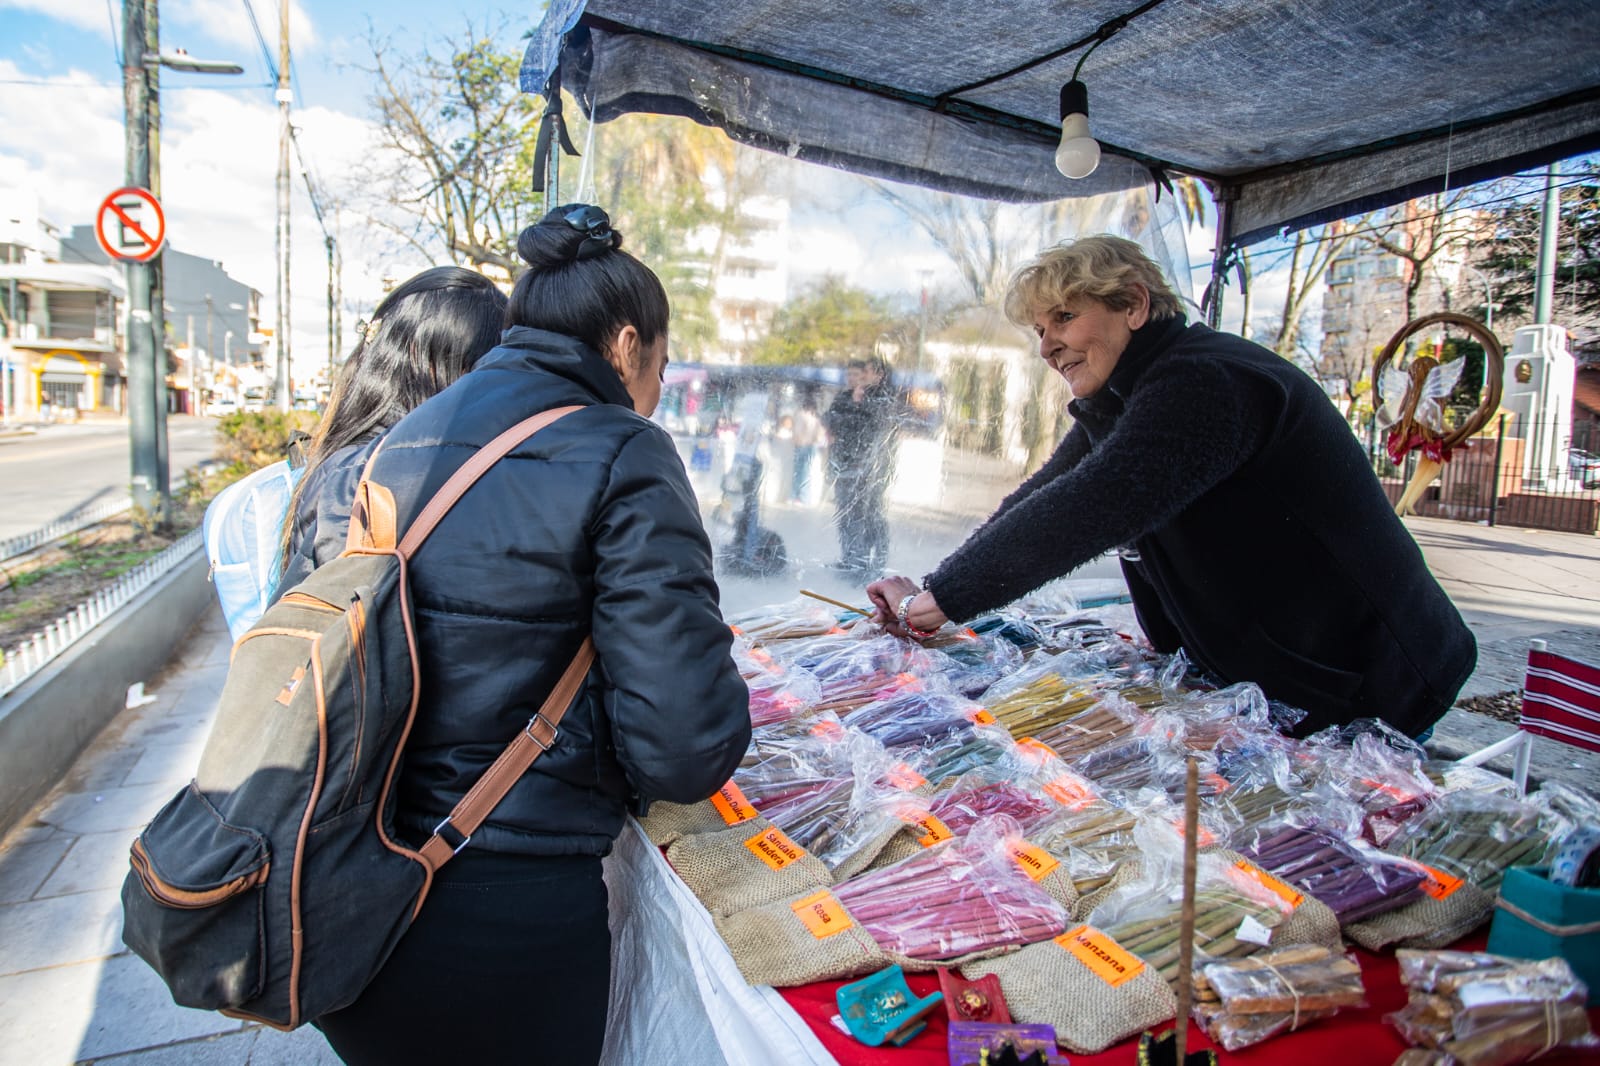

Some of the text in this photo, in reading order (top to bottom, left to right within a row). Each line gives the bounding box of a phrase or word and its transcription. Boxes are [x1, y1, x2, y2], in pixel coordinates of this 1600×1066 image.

[118, 202, 146, 248] E
[729, 800, 747, 822] Dulce
[756, 840, 785, 865] Madera
[812, 903, 832, 924] Rosa
